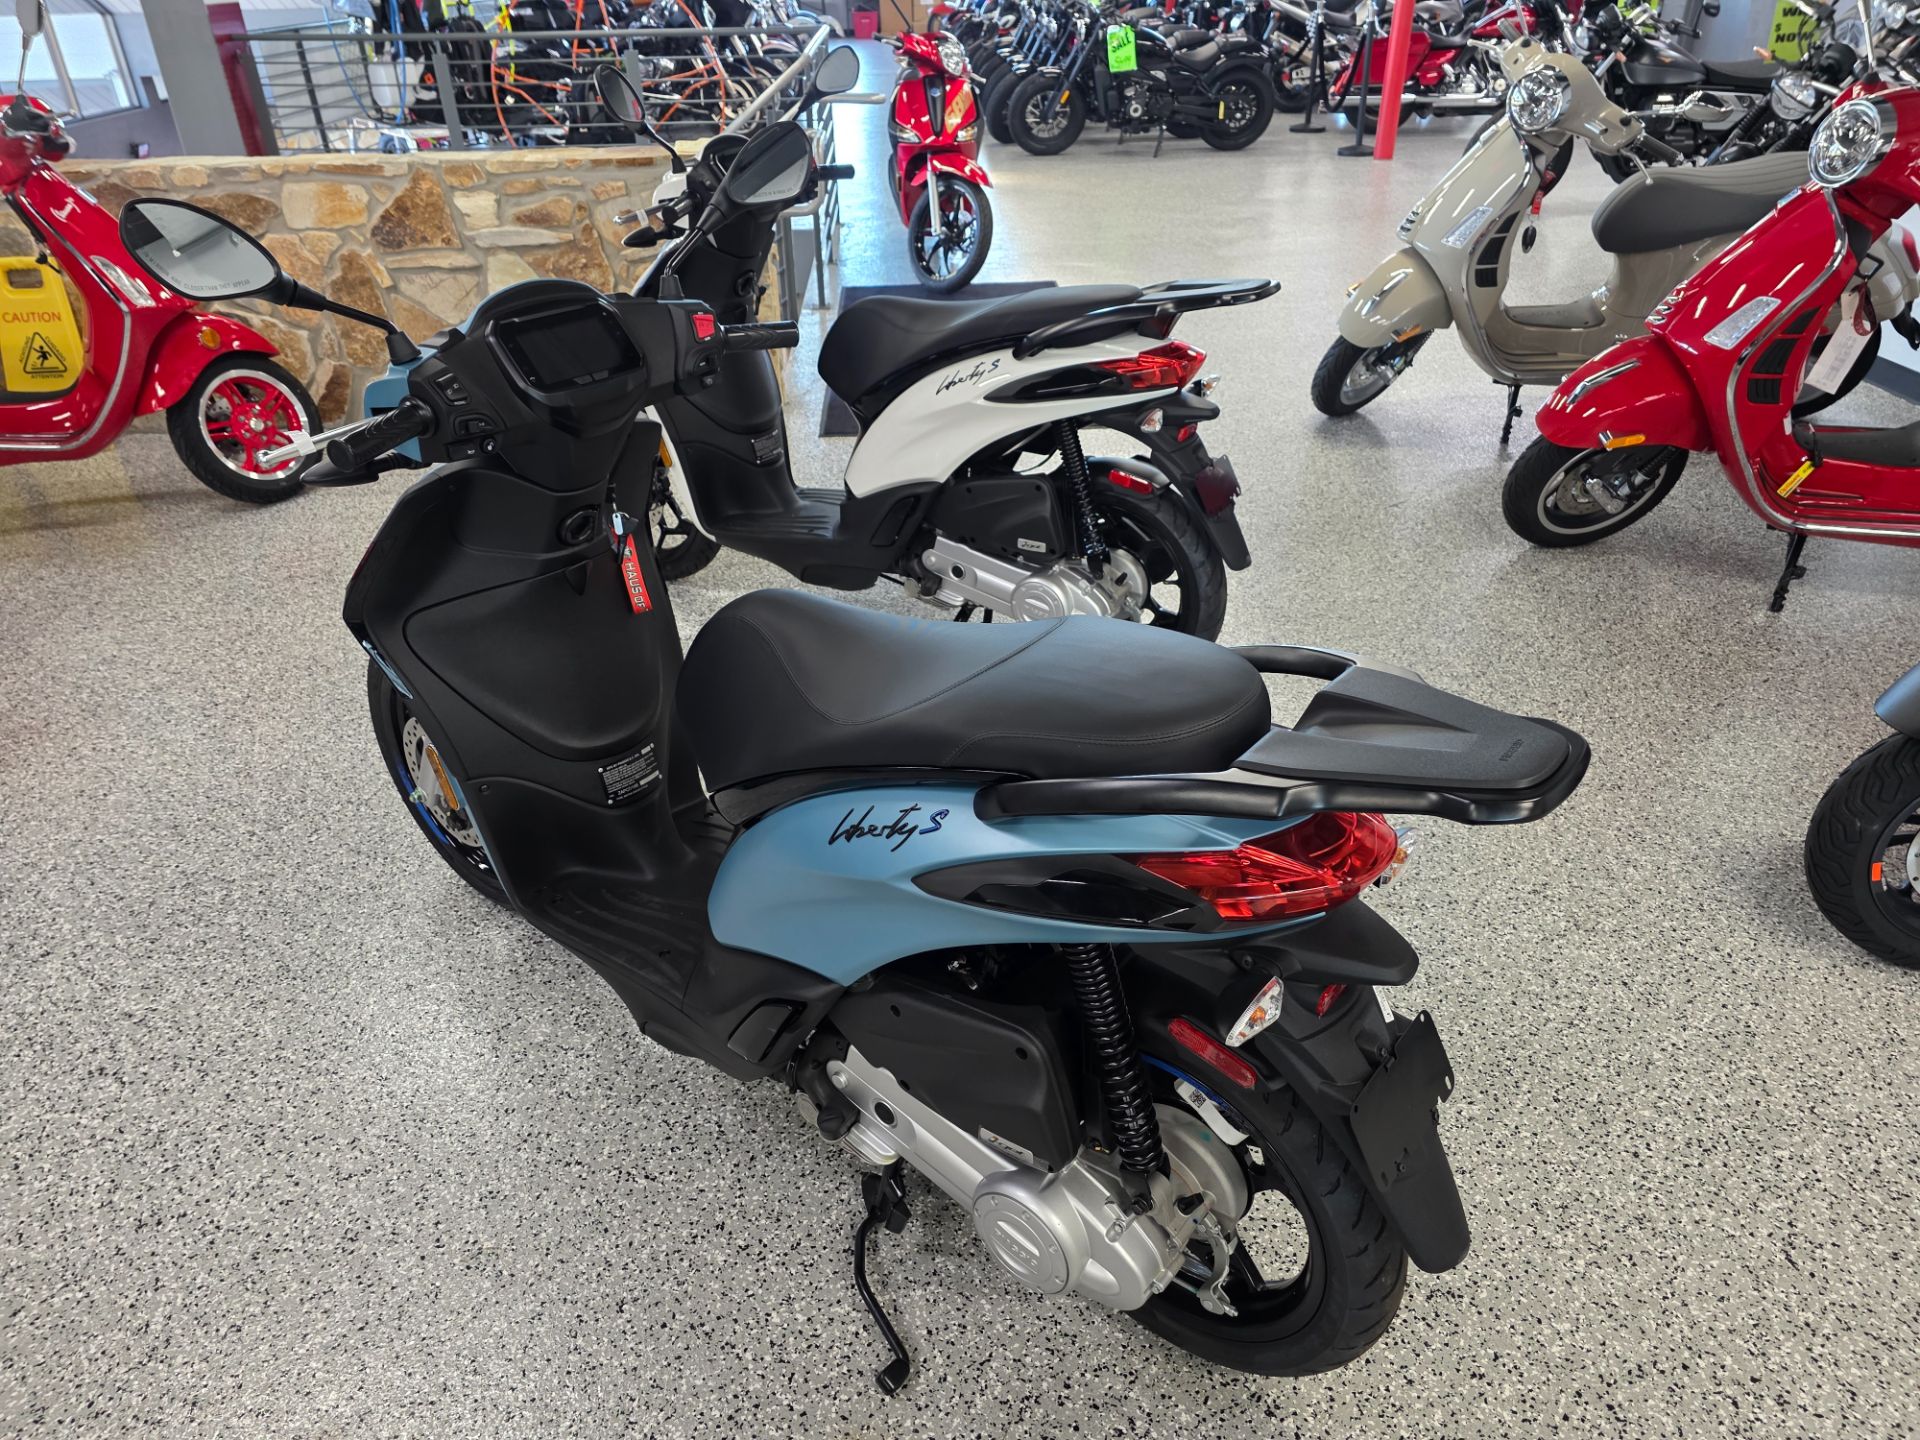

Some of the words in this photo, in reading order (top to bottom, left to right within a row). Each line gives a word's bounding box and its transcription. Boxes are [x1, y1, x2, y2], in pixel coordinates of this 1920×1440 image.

[1775, 32, 1814, 43] NOW
[2, 311, 62, 323] CAUTION
[936, 361, 986, 395] Liberty
[987, 358, 1001, 373] S
[625, 562, 643, 594] HAUS
[634, 595, 646, 609] OF
[828, 803, 921, 852] Liberty
[919, 808, 950, 835] S
